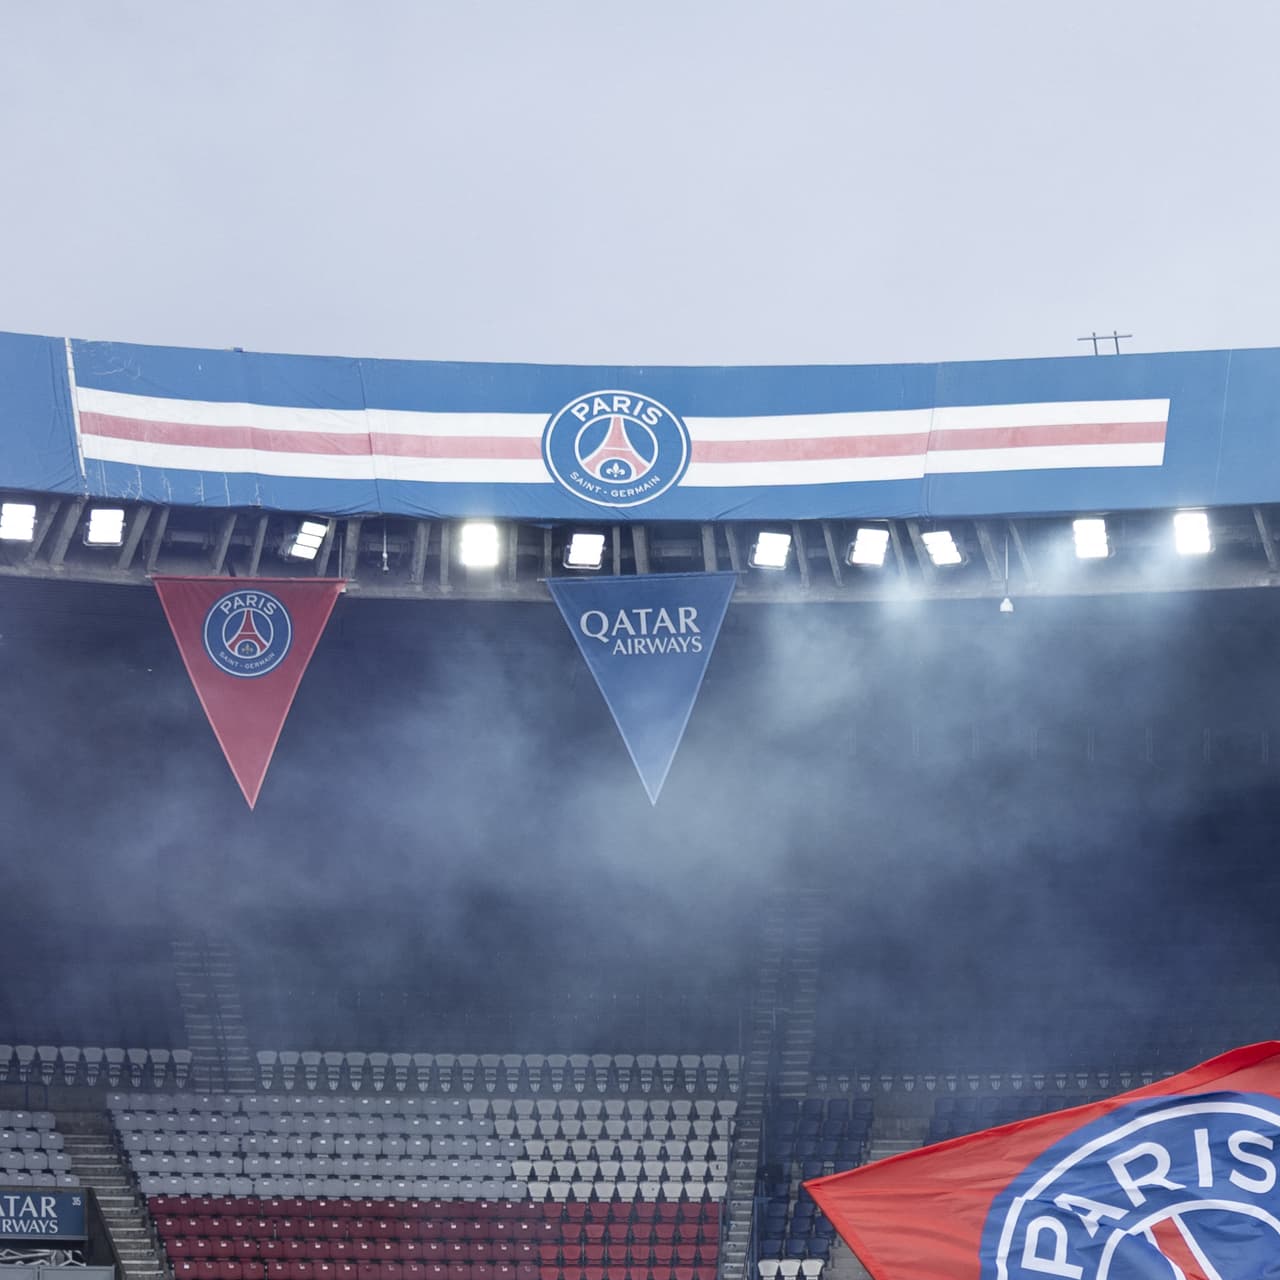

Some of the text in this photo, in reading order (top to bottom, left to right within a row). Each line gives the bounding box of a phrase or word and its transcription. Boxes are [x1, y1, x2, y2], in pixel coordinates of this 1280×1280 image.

[570, 396, 663, 425] PARIS
[220, 594, 277, 616] PARIS
[580, 607, 701, 643] QATAR
[612, 635, 703, 655] AIRWAYS
[1021, 1128, 1277, 1280] PARIS
